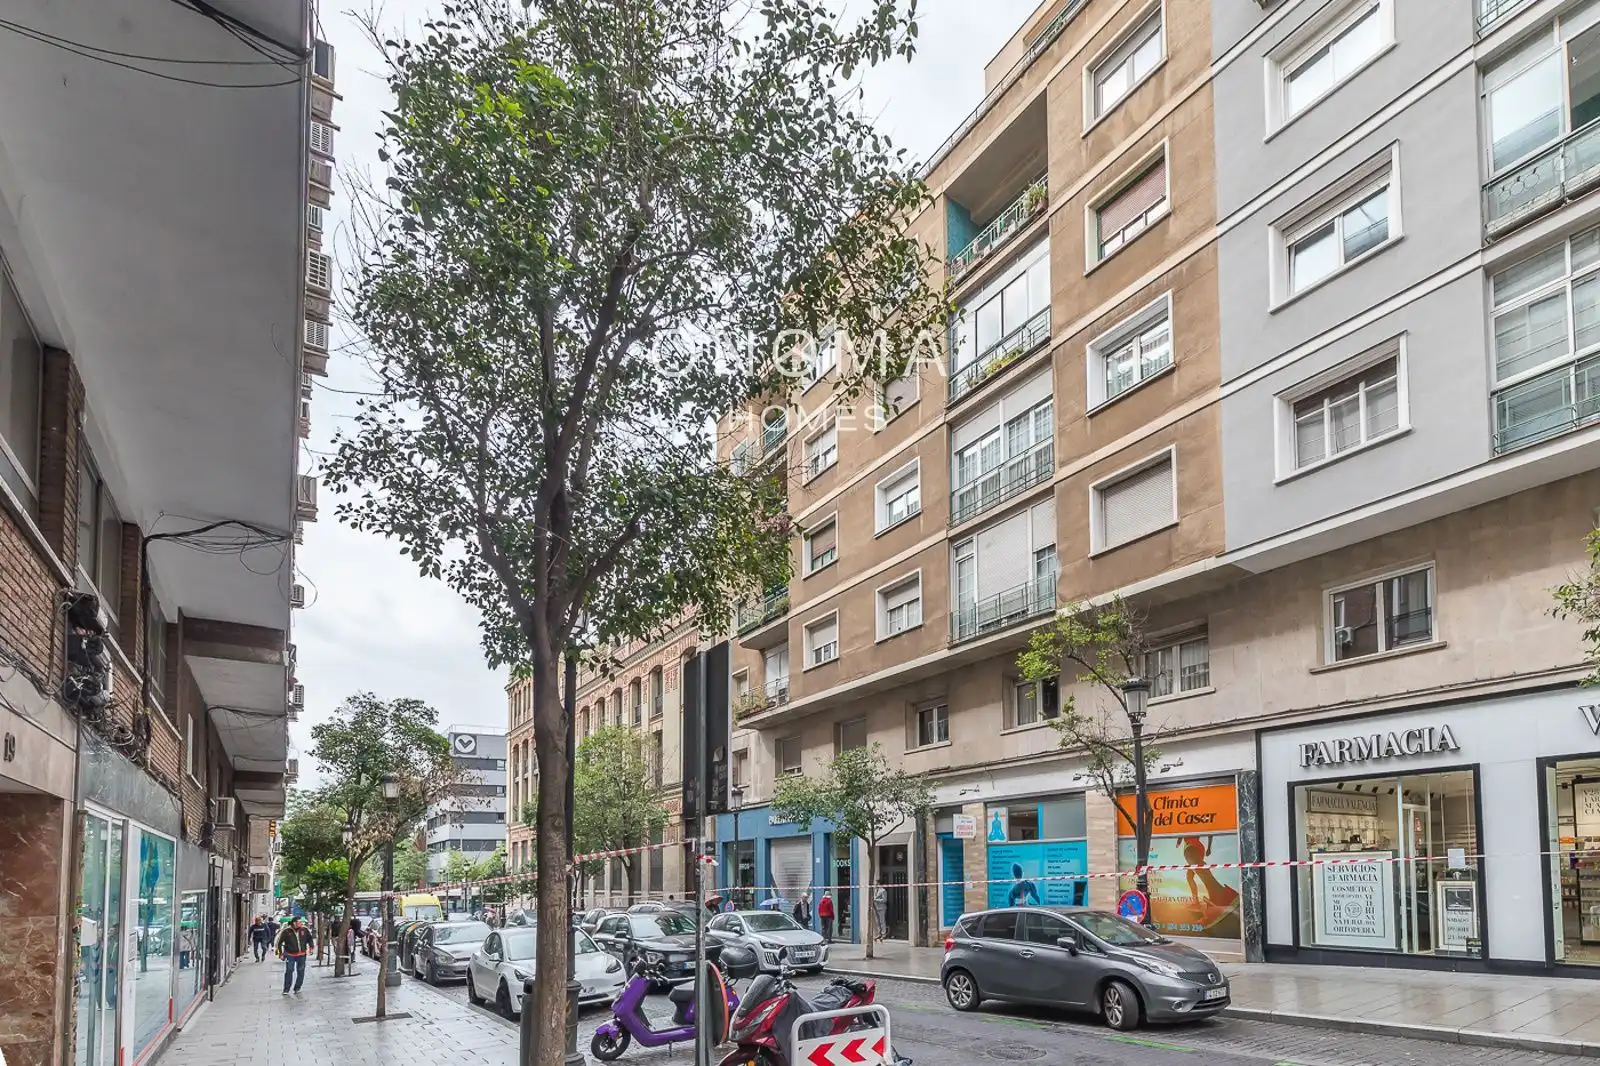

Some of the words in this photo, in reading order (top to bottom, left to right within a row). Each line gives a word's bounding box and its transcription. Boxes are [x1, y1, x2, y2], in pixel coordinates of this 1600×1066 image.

[4, 731, 16, 762] 19
[1299, 724, 1460, 767] FARMACIA
[1153, 812, 1173, 827] del
[1176, 812, 1217, 826] Casar
[1327, 864, 1377, 873] SERVICIOS
[1332, 873, 1378, 882] FARMACIA
[1333, 926, 1376, 934] ORTOPEDIA
